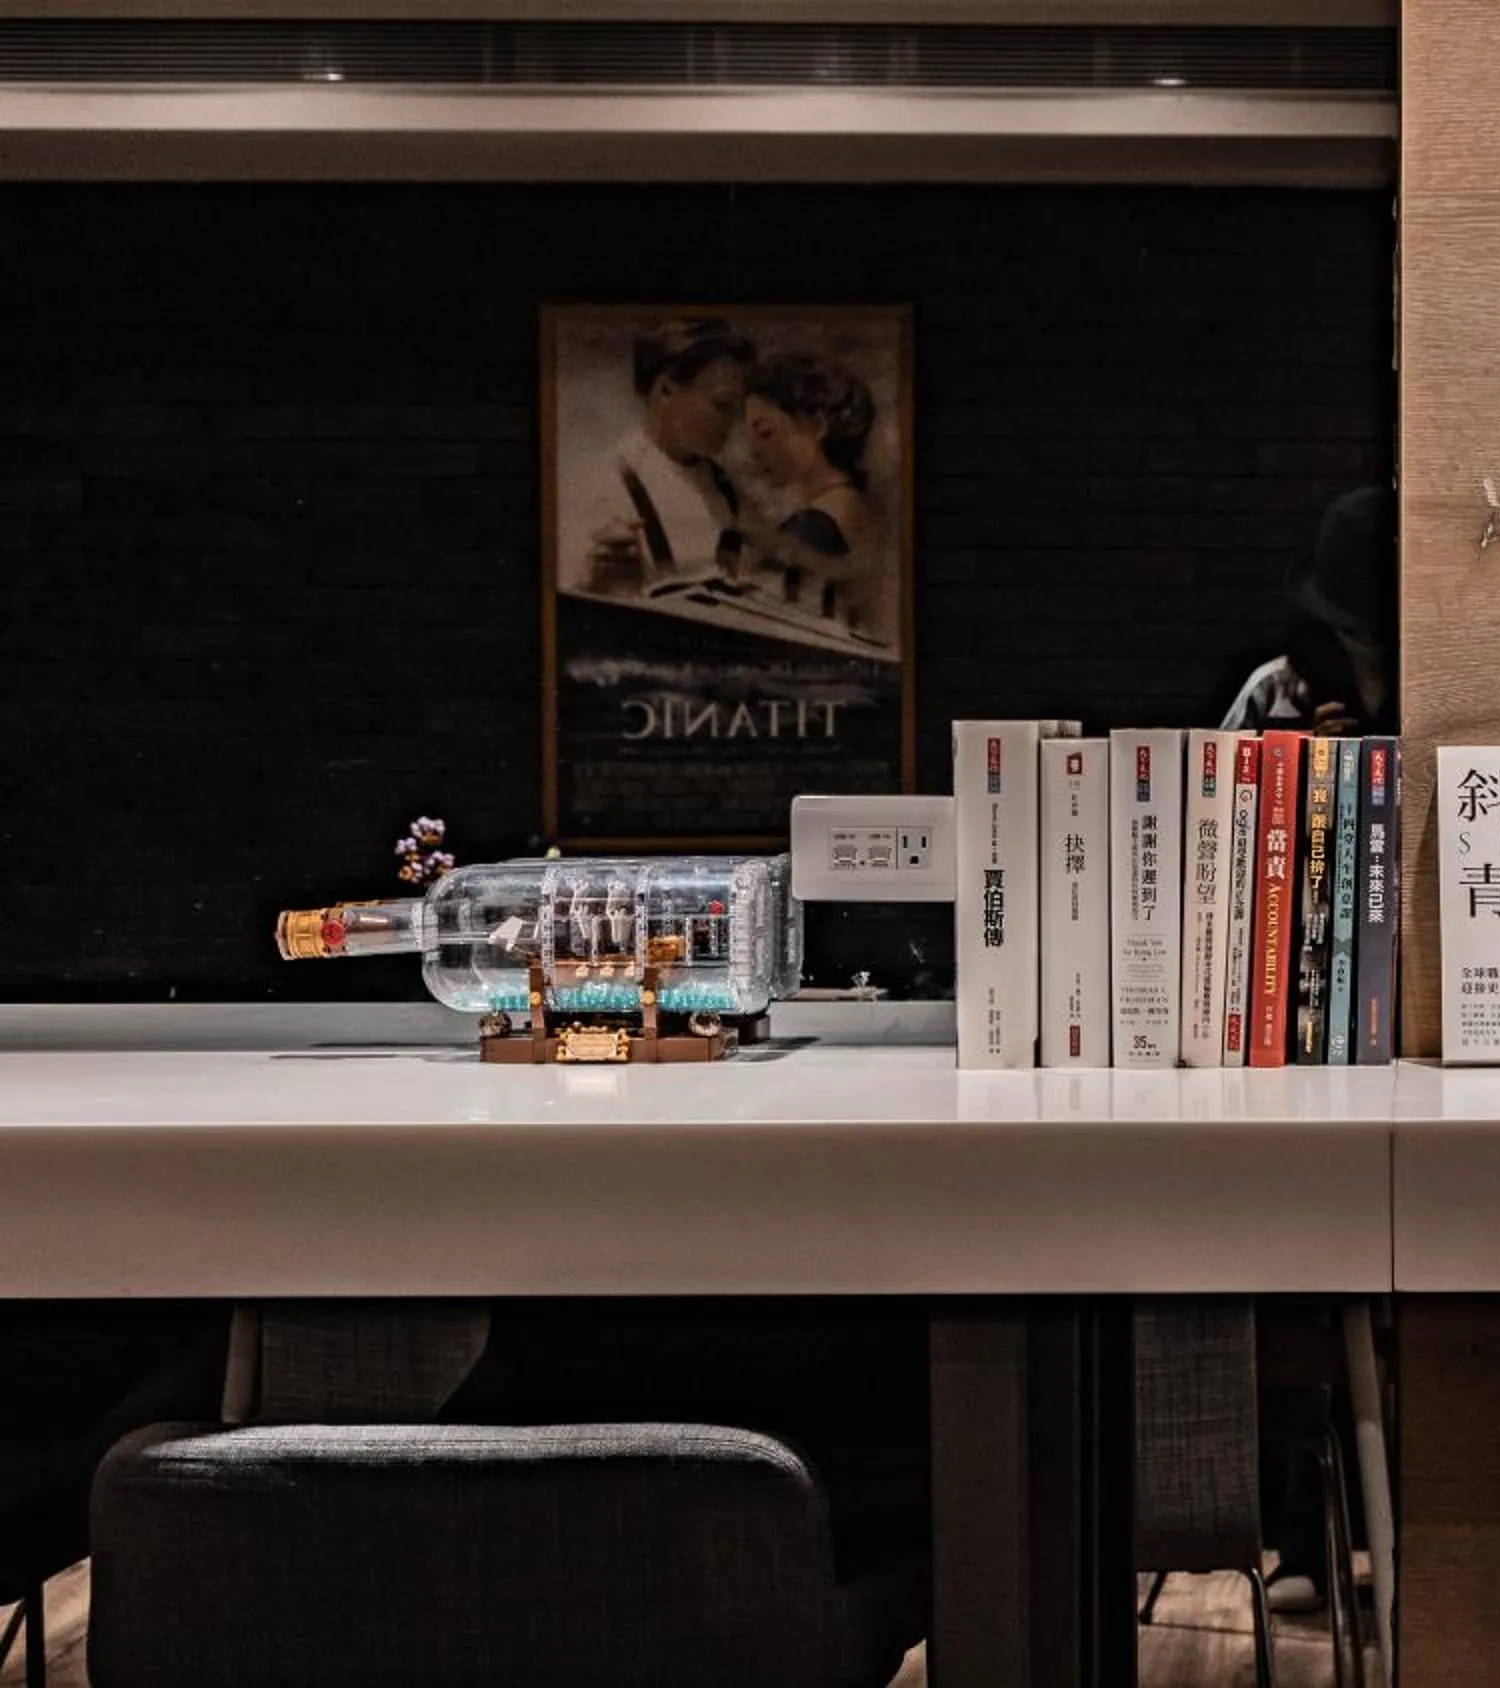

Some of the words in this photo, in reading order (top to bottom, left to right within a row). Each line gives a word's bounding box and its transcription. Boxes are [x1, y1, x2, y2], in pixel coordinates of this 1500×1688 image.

[1064, 833, 1086, 875] 抉擇
[1266, 829, 1289, 881] 當責
[983, 869, 1005, 948] 賈伯斯傳
